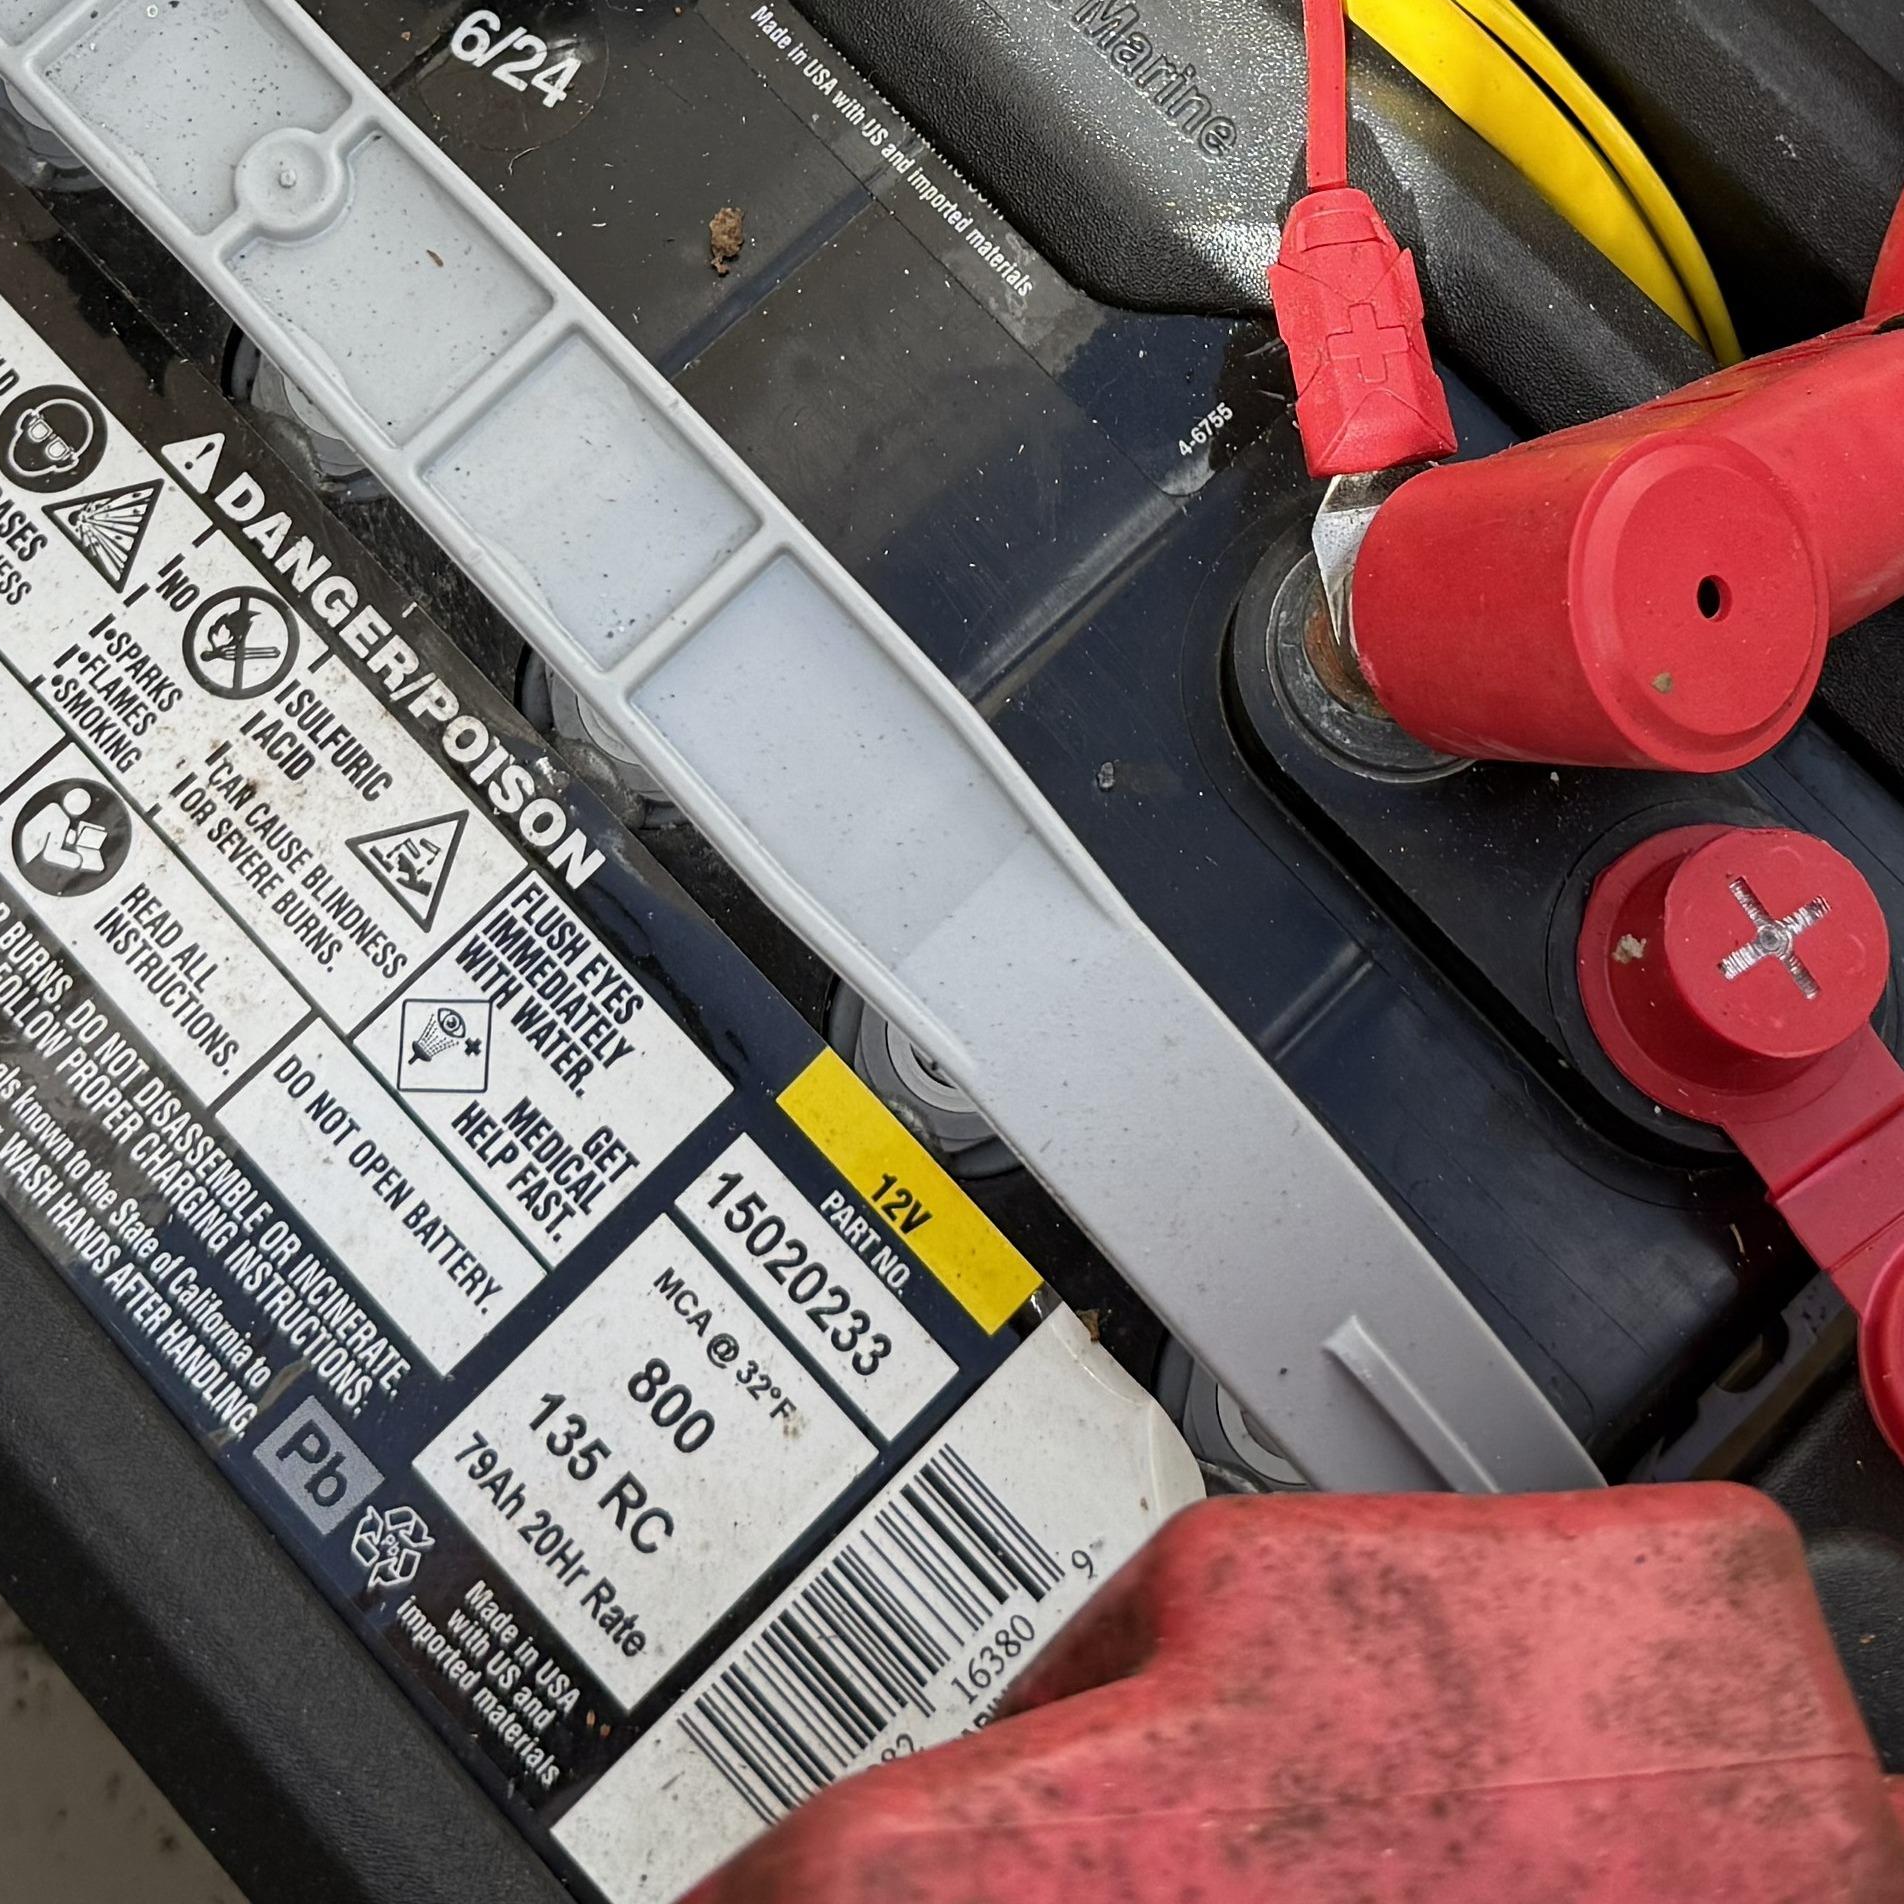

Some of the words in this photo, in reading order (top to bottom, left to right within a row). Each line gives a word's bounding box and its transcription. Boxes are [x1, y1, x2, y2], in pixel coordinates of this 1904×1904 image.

[450, 9, 582, 110] 6/24
[748, 3, 796, 52] Made
[786, 41, 811, 67] in
[801, 57, 839, 96] USA
[828, 86, 869, 127] with
[858, 116, 890, 148] US
[879, 138, 916, 174] and
[903, 165, 974, 237] imported
[963, 224, 1037, 298] materials
[1179, 402, 1234, 456] 4-6755
[152, 567, 203, 614] NO
[208, 470, 611, 890] DANGER/POISON
[280, 686, 397, 804] SULFURIC
[249, 715, 324, 788] ACID
[117, 882, 188, 951] READ
[169, 940, 226, 994] ALL
[174, 784, 222, 828] OR
[203, 816, 287, 900] SEVERE
[268, 888, 353, 974] BURNS.
[198, 756, 261, 814] CAN
[241, 800, 316, 875] CAUSE
[297, 863, 412, 981] BLINDNESS
[90, 906, 250, 1076] INSTRUCTIONS.
[445, 933, 527, 1012] WITH
[502, 995, 608, 1101] WATER.
[476, 906, 635, 1070] IMMEDIATELY
[505, 879, 594, 967] FLUSH
[571, 952, 648, 1027] EYES
[269, 1053, 320, 1101] DO
[300, 1089, 362, 1148] NOT
[343, 1137, 418, 1212] OPEN
[396, 1199, 510, 1316] BATTERY.
[446, 1099, 524, 1175] HELP
[501, 1161, 585, 1244] FAST.
[497, 1096, 616, 1216] MEDICAL
[575, 1123, 642, 1185] GET
[863, 1169, 933, 1237] 12V
[695, 1166, 903, 1382] 15020233
[812, 1185, 882, 1254] PART
[866, 1245, 921, 1298] NO.
[648, 1266, 722, 1338] MCA
[698, 1328, 747, 1372] @
[270, 1418, 365, 1513] Pb
[510, 1381, 619, 1486] 135
[590, 1470, 684, 1559] RC
[618, 1355, 724, 1458] 800
[448, 1430, 537, 1521] 79Ah
[514, 1506, 597, 1590] 20Hr
[575, 1577, 661, 1664] Rate
[388, 1594, 485, 1695] imported
[468, 1683, 569, 1790] materials
[441, 1605, 497, 1660] with
[480, 1649, 526, 1692] US
[507, 1681, 561, 1733] and
[460, 1579, 525, 1646] Made
[509, 1636, 546, 1670] in
[528, 1658, 586, 1717] USA
[951, 1614, 1035, 1705] 16380
[1071, 1549, 1097, 1580] 9
